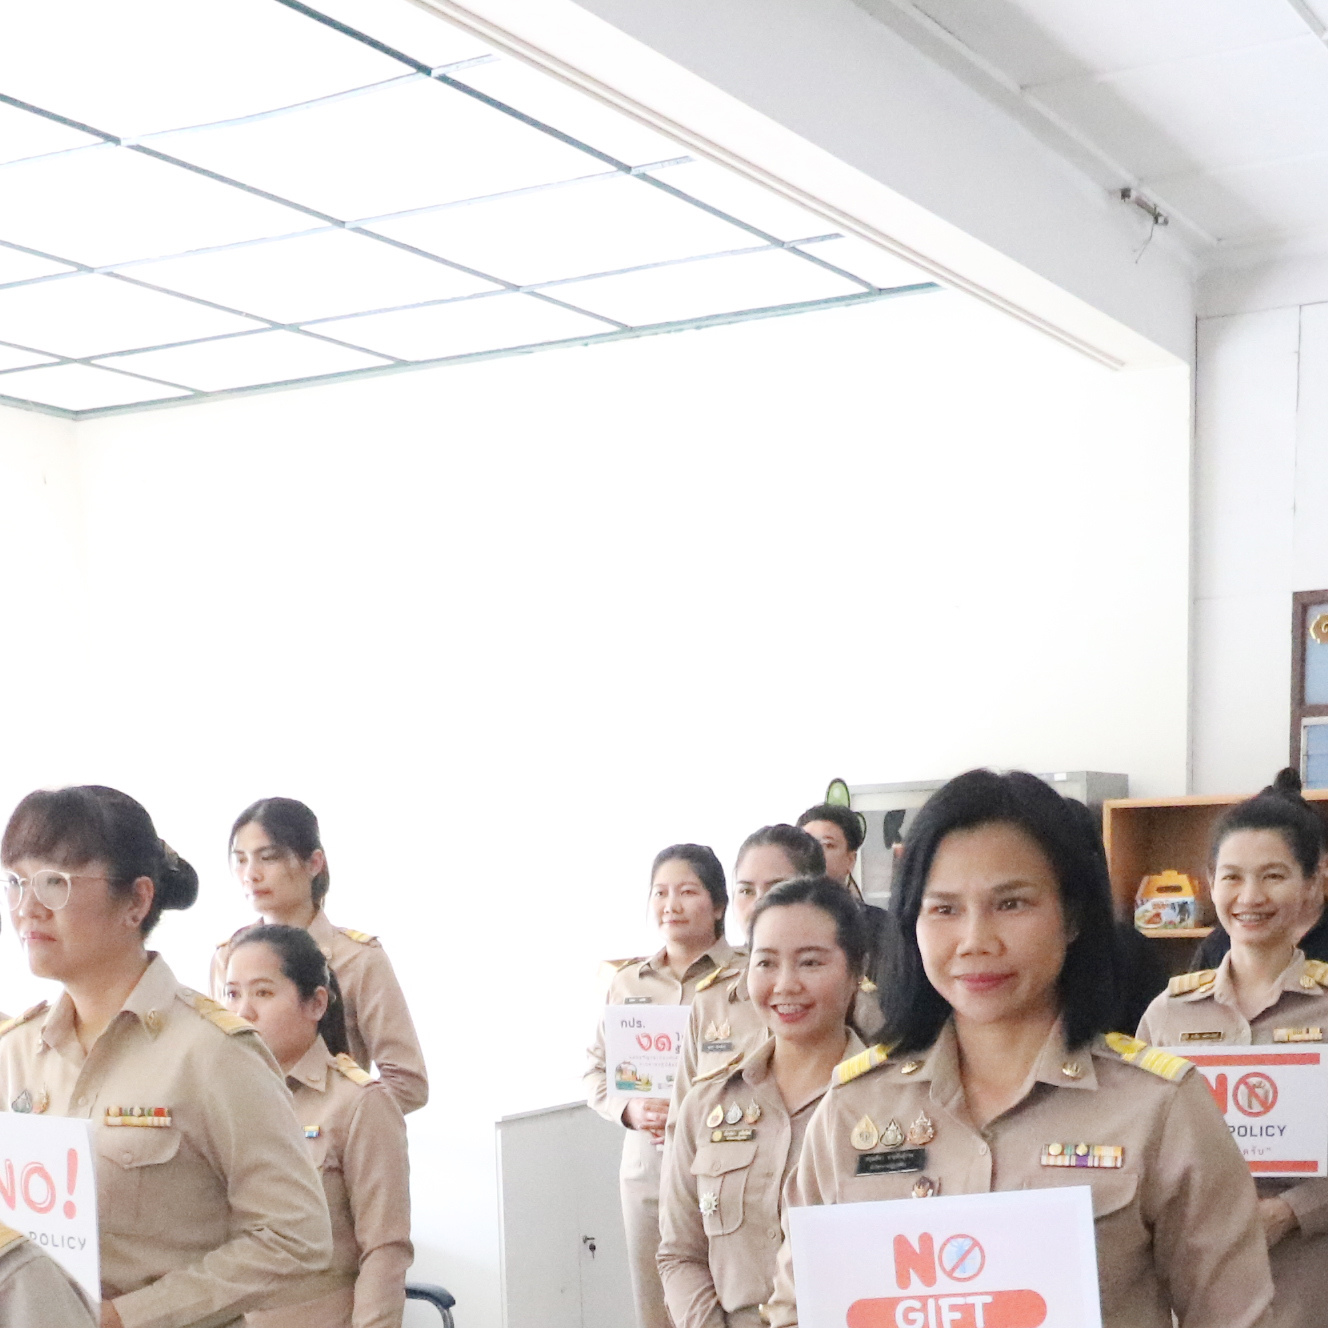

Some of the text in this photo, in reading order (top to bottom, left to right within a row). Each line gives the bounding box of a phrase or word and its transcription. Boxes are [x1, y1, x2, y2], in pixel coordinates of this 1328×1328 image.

[620, 1017, 646, 1029] กปร.
[635, 1032, 672, 1053] งด
[29, 1231, 87, 1251] POLICY
